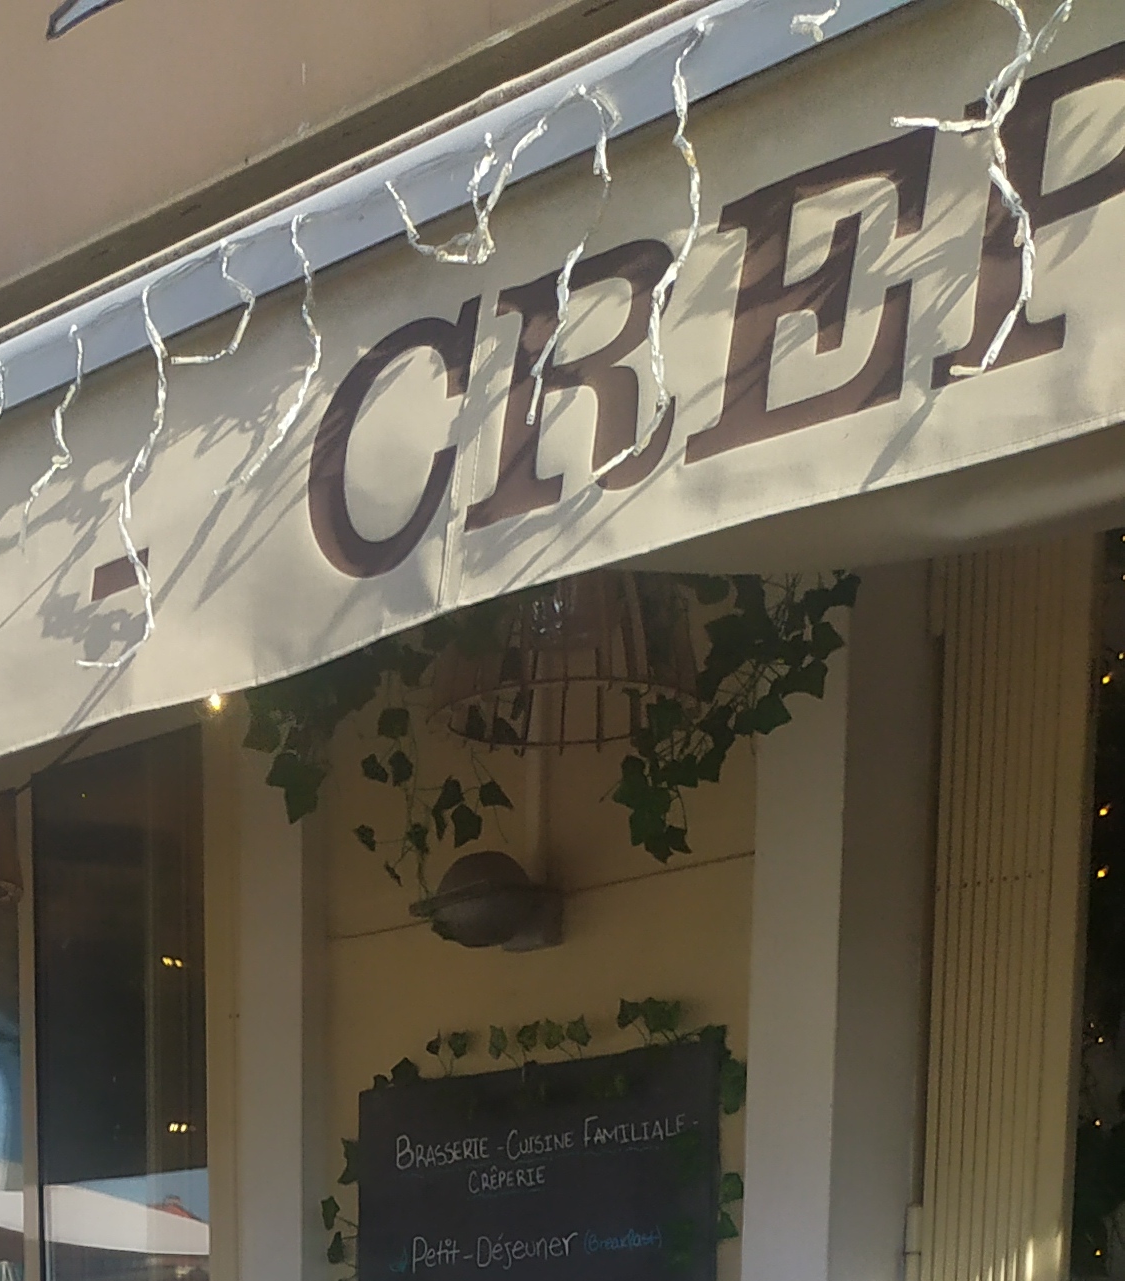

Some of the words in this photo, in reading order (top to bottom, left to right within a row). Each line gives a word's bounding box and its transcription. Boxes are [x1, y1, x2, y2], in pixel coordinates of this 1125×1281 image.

[307, 40, 1125, 580] CREP
[395, 1133, 490, 1171] BRASSERIE
[583, 1113, 686, 1148] FAMILIALE
[468, 1165, 546, 1194] CRÊPERIE
